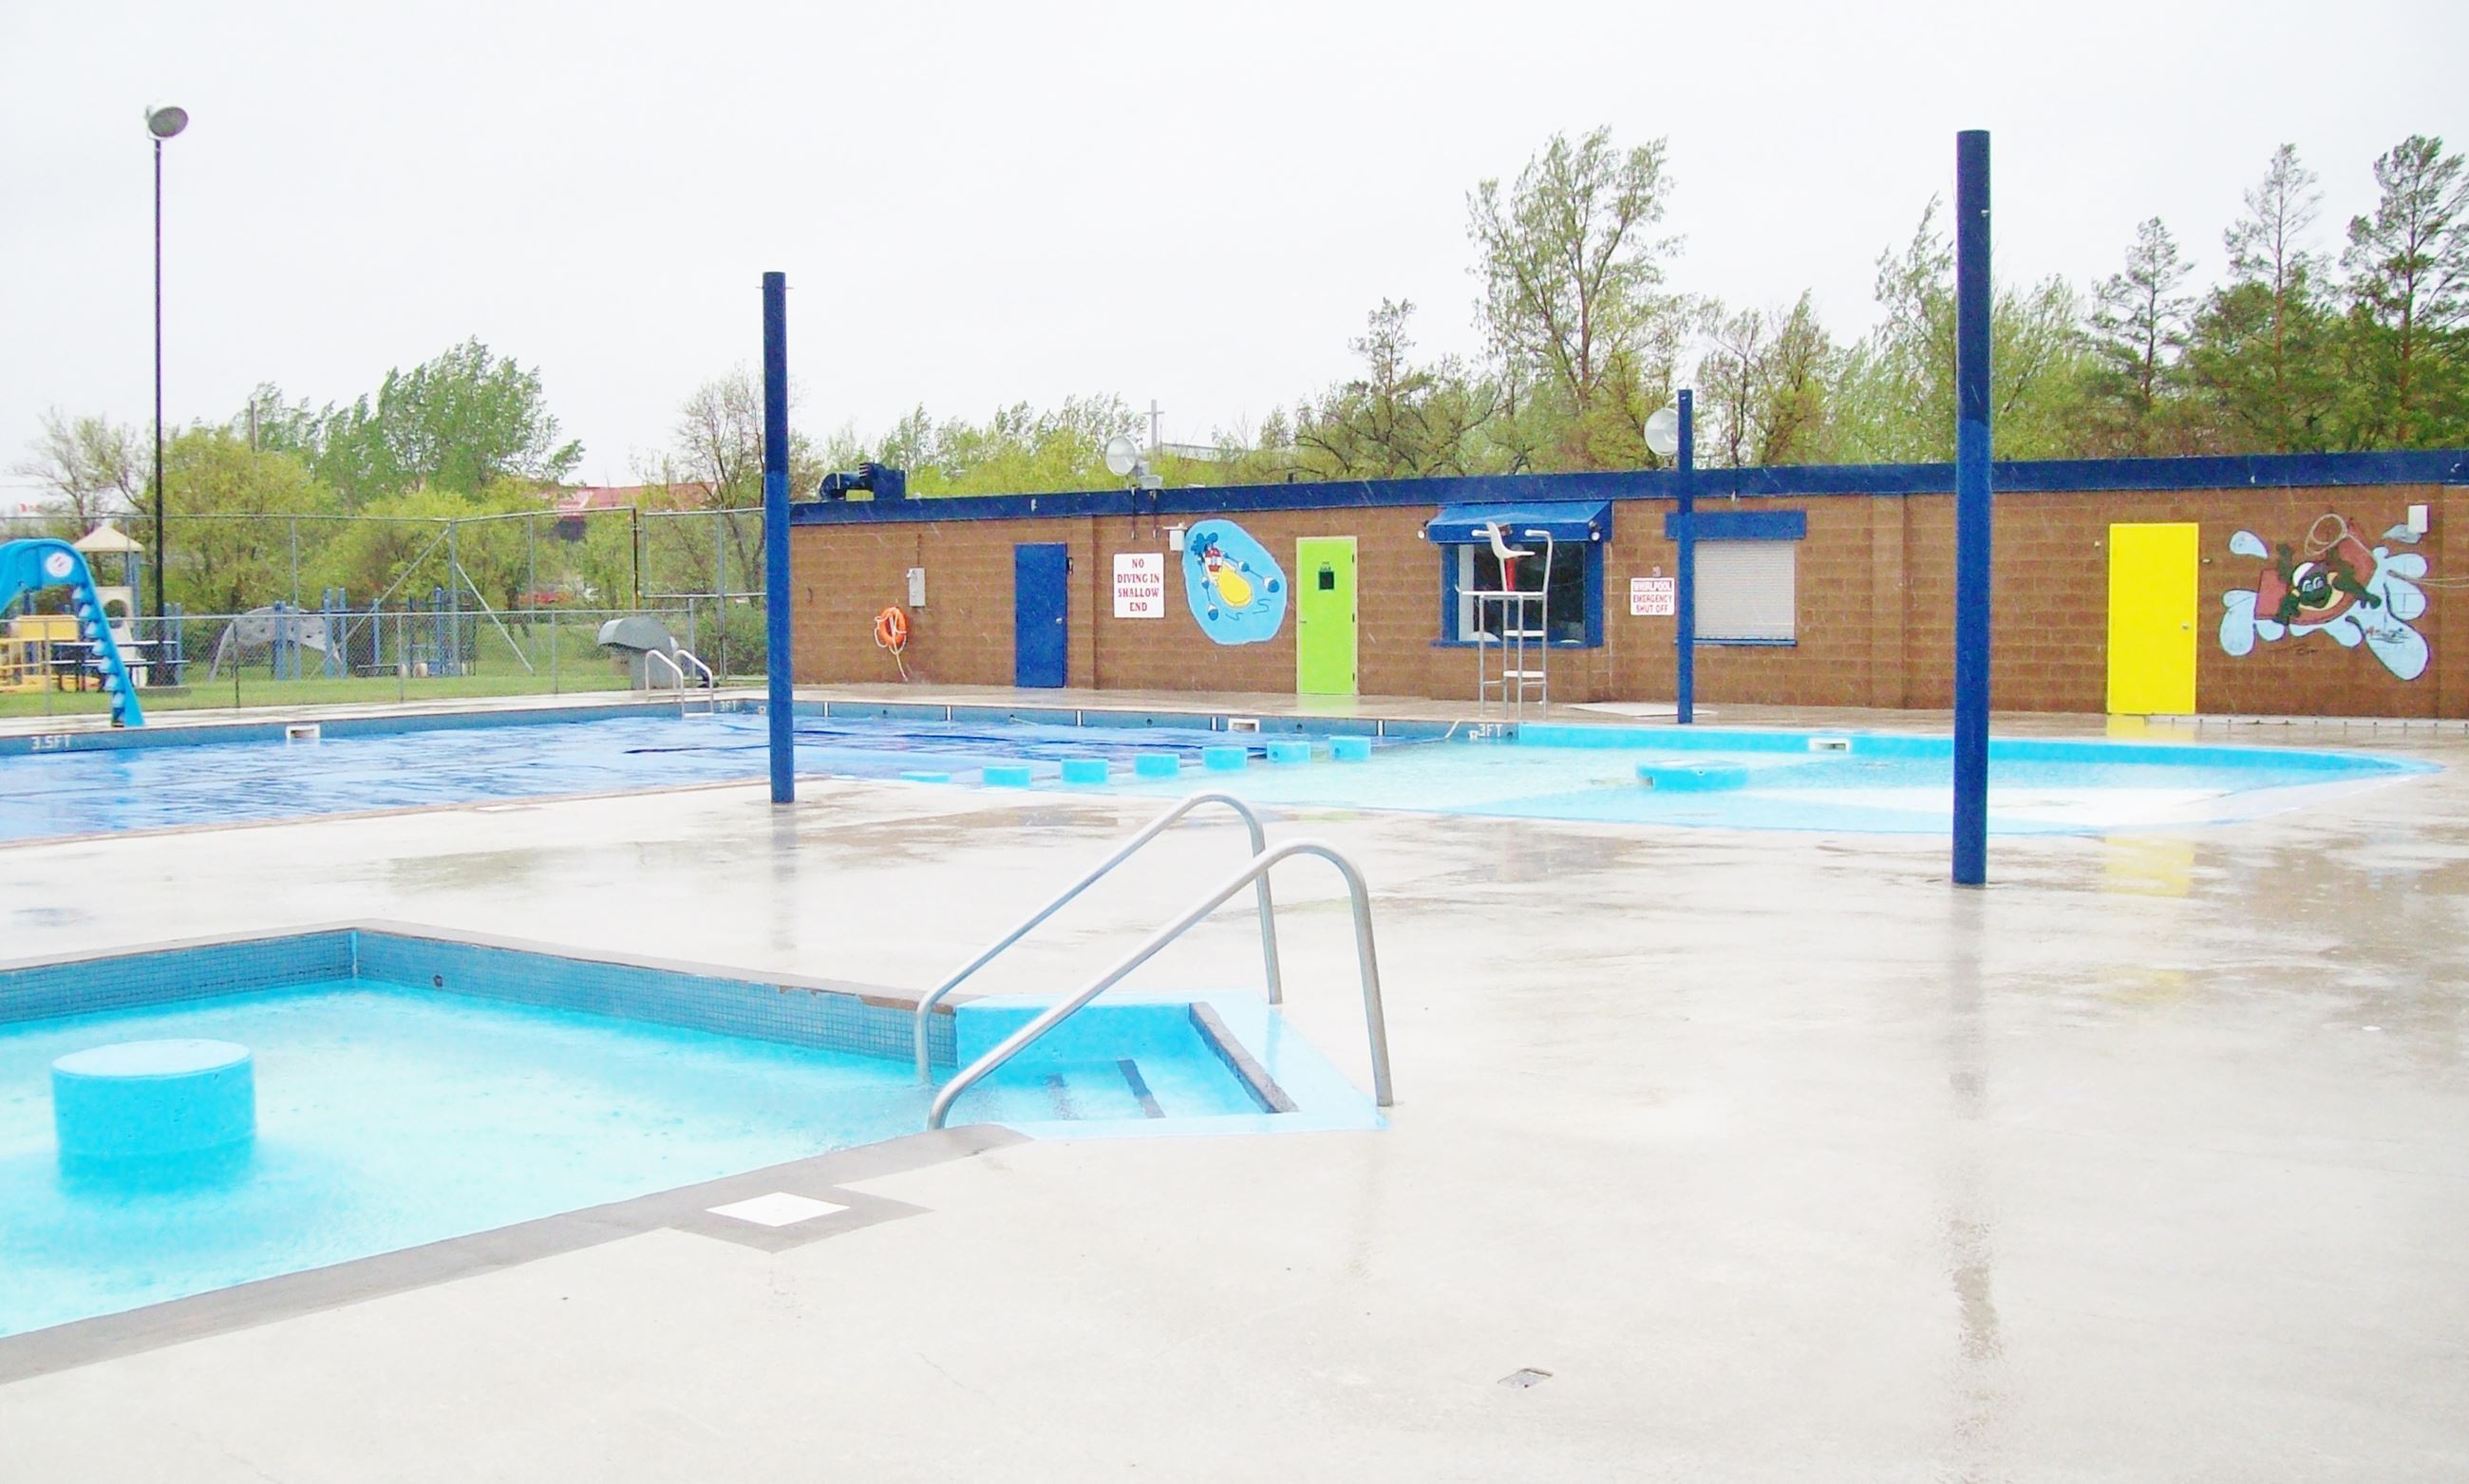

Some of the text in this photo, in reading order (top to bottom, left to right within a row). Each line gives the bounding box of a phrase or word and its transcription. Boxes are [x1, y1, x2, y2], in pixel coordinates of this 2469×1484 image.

[1132, 558, 1144, 568] NO
[1117, 573, 1159, 583] DIVING IN
[1118, 588, 1159, 597] SHALLOW
[1633, 594, 1672, 603] EMERGENCY
[1129, 602, 1147, 611] END
[1636, 605, 1653, 613] SHUT
